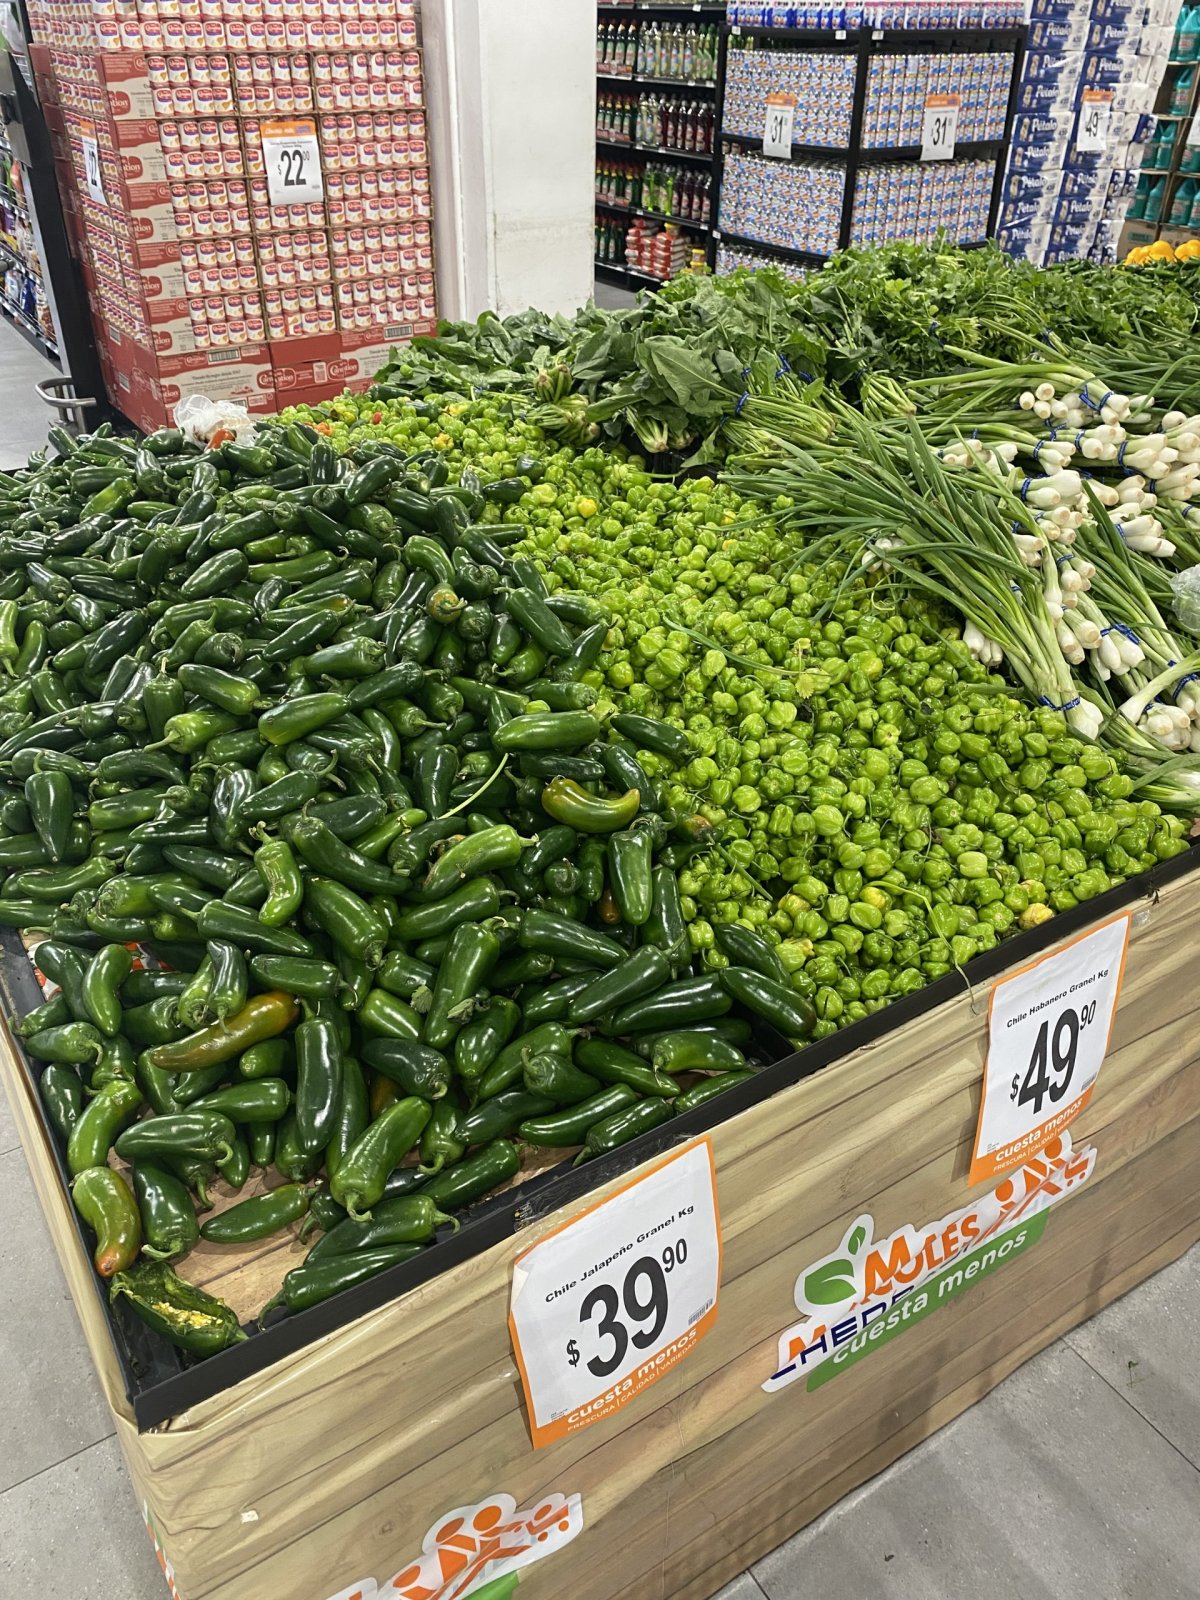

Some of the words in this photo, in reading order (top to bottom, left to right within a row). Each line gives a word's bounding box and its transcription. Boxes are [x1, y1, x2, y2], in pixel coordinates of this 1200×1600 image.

[771, 115, 783, 143] 31
[933, 116, 947, 145] 31
[1085, 111, 1098, 137] 49
[1006, 1013, 1027, 1028] Chile
[1029, 991, 1067, 1016] Habanero
[1069, 975, 1096, 993] Granel
[1097, 969, 1109, 979] Kg
[995, 1130, 1041, 1161] cuesta
[1044, 1098, 1082, 1133] menos
[993, 1153, 1027, 1172] FRESCURA
[545, 1280, 577, 1303] Chile
[580, 1242, 634, 1281] Jalapeño
[636, 1216, 675, 1243] Granel
[678, 1205, 694, 1219] Kg
[833, 1293, 928, 1364] cuesta
[938, 1229, 1027, 1297] menos
[567, 1377, 633, 1424] cuesta
[637, 1328, 697, 1378] menos
[567, 1405, 615, 1431] FRESCURA
[621, 1374, 656, 1402] CALIDAD
[660, 1339, 697, 1370] VARIEDAD
